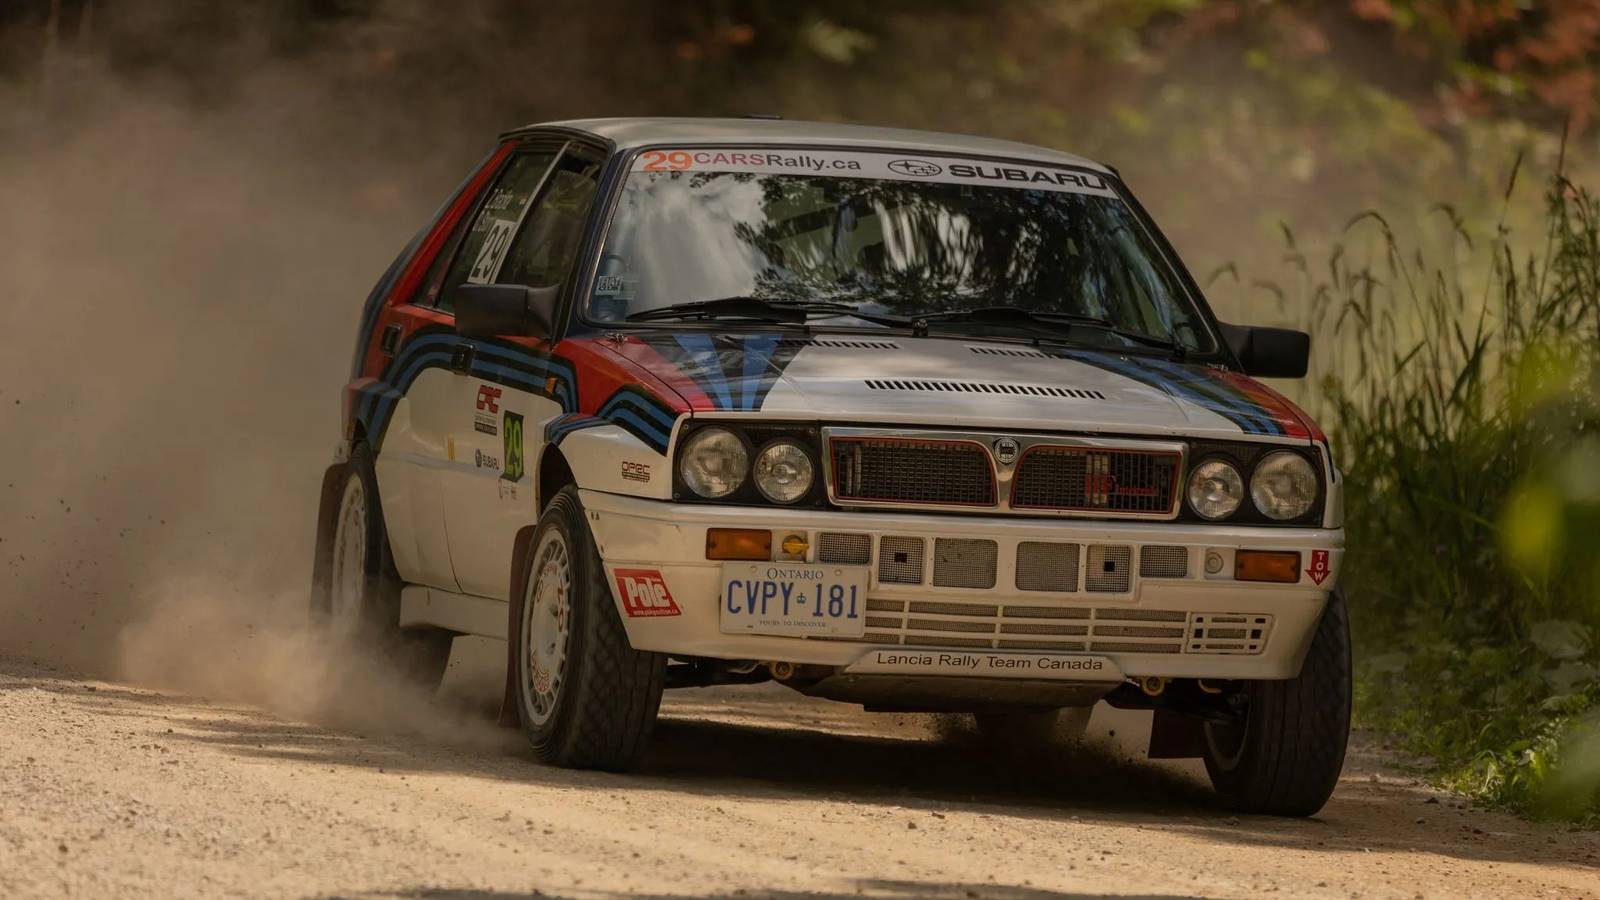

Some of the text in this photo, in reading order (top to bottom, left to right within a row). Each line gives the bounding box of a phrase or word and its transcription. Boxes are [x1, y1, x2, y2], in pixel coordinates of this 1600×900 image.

[643, 151, 862, 171] 29 CARSRally.ca
[948, 164, 1107, 190] SUBARU
[470, 224, 510, 284] 29
[504, 416, 522, 478] 29
[1315, 551, 1325, 581] TOW
[727, 580, 859, 618] CVPY 181
[877, 652, 1103, 670] Lancia Rally Team Canada
